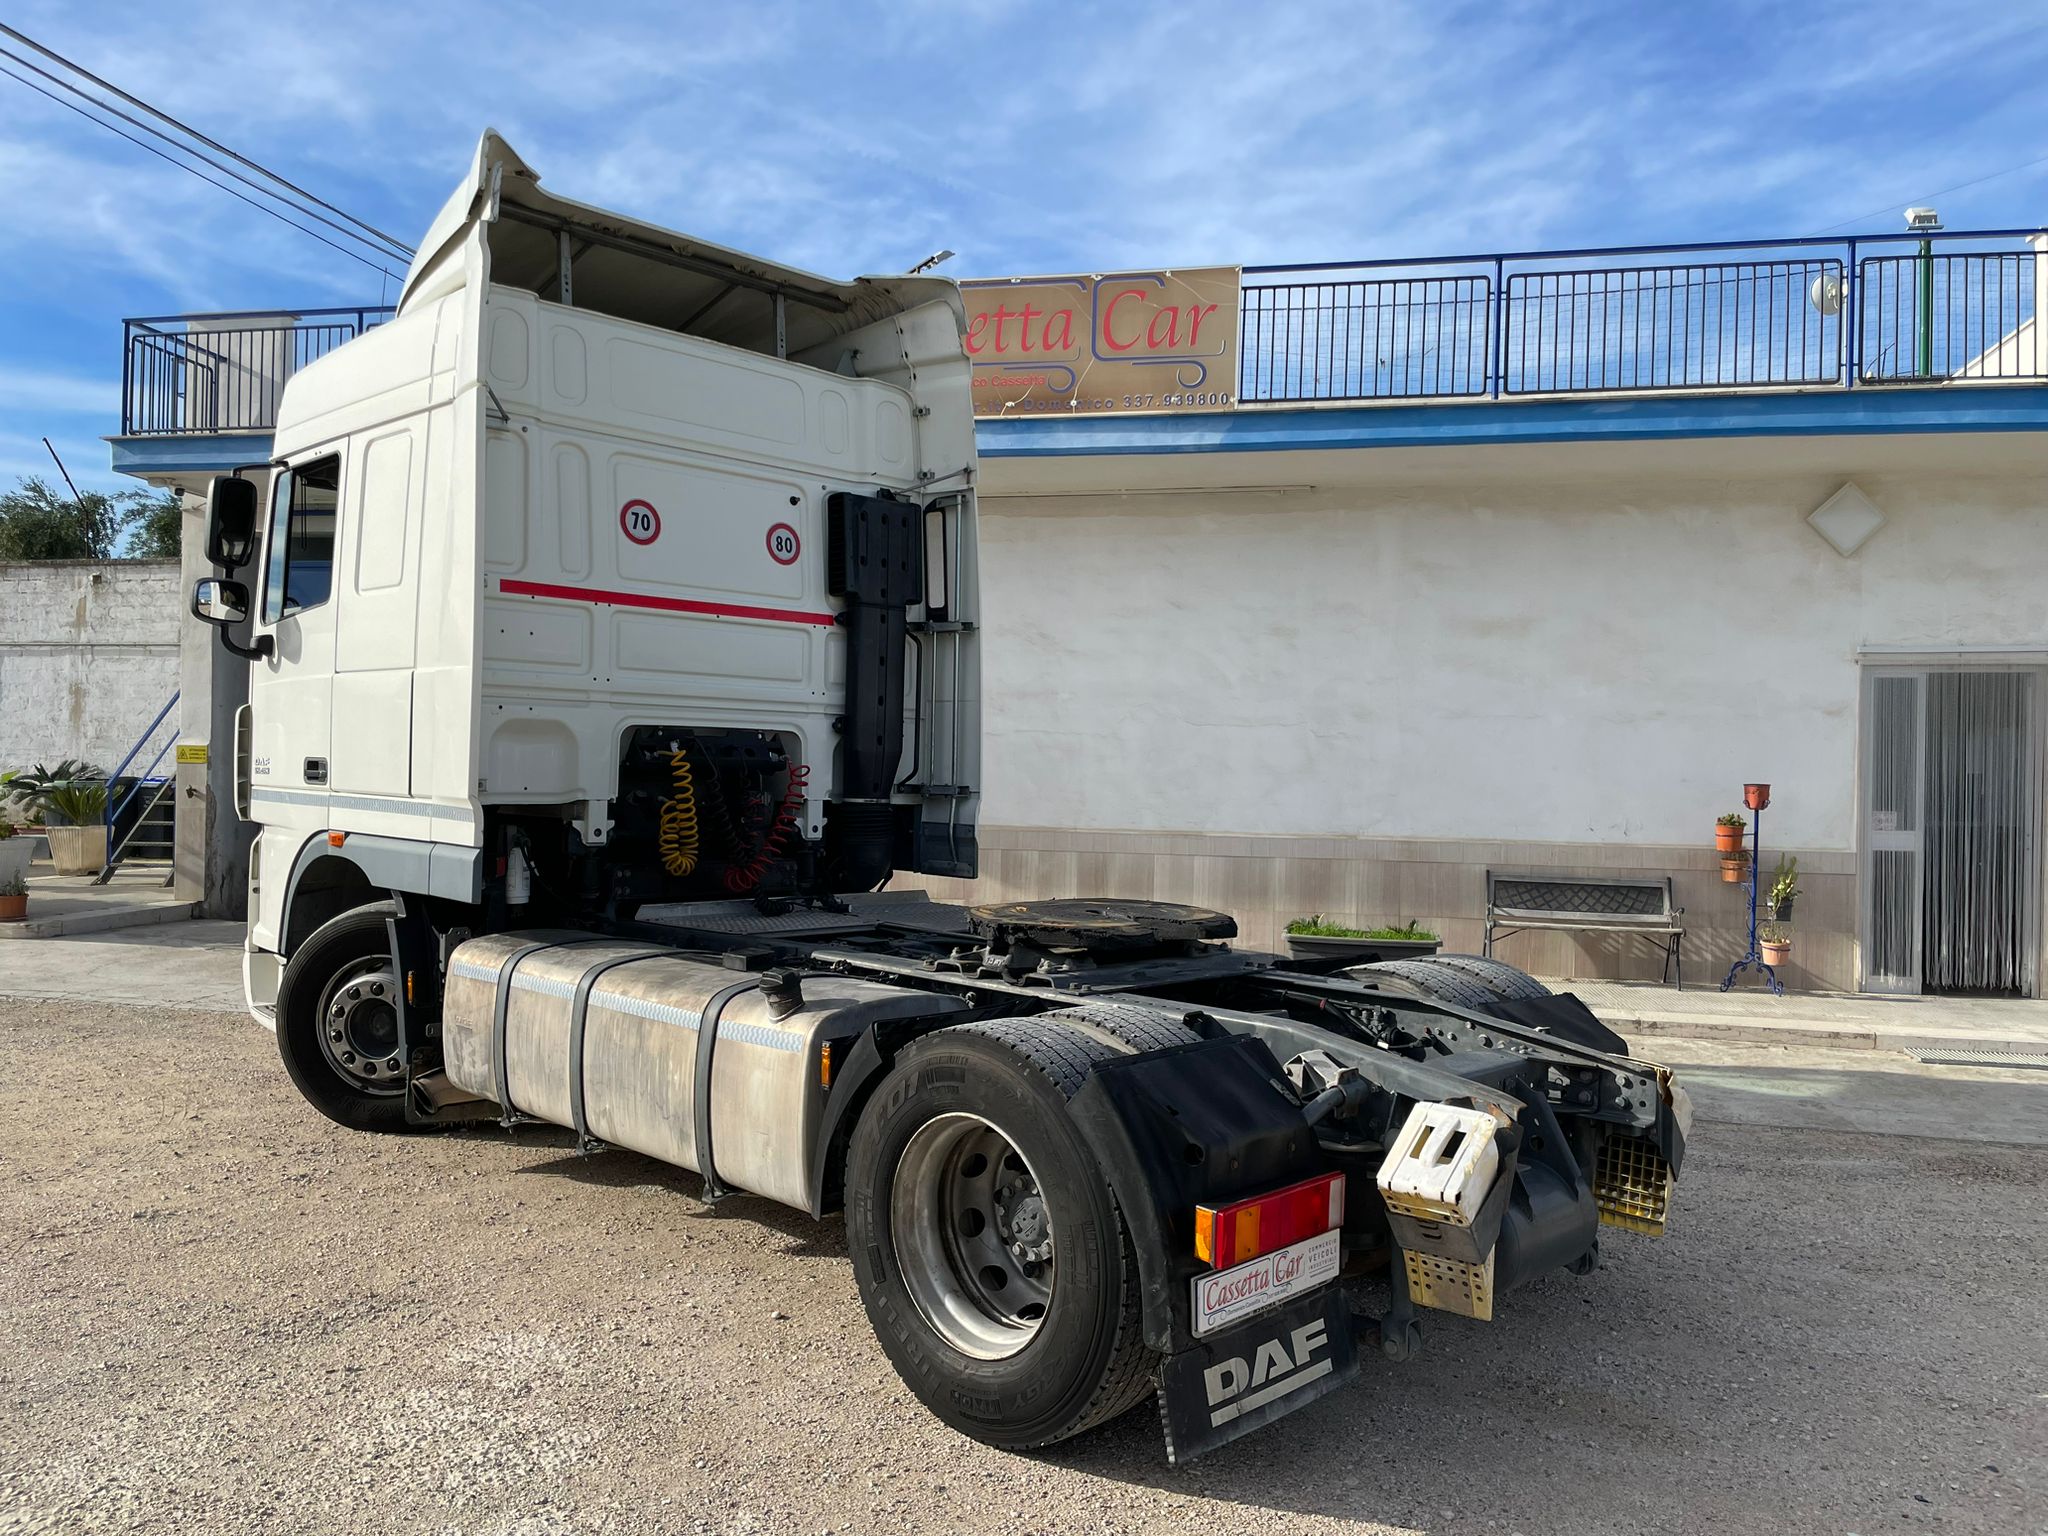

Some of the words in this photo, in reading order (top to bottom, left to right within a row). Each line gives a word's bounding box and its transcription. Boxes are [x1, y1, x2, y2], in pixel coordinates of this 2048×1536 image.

[1103, 290, 1218, 351] Car
[1123, 392, 1229, 408] 337.939800
[631, 512, 650, 531] 70
[776, 536, 792, 553] 80
[1308, 1245, 1337, 1263] VEICOLI
[1206, 1268, 1270, 1311] Cassetta
[1275, 1253, 1304, 1283] Car
[1203, 1317, 1329, 1407] DAF
